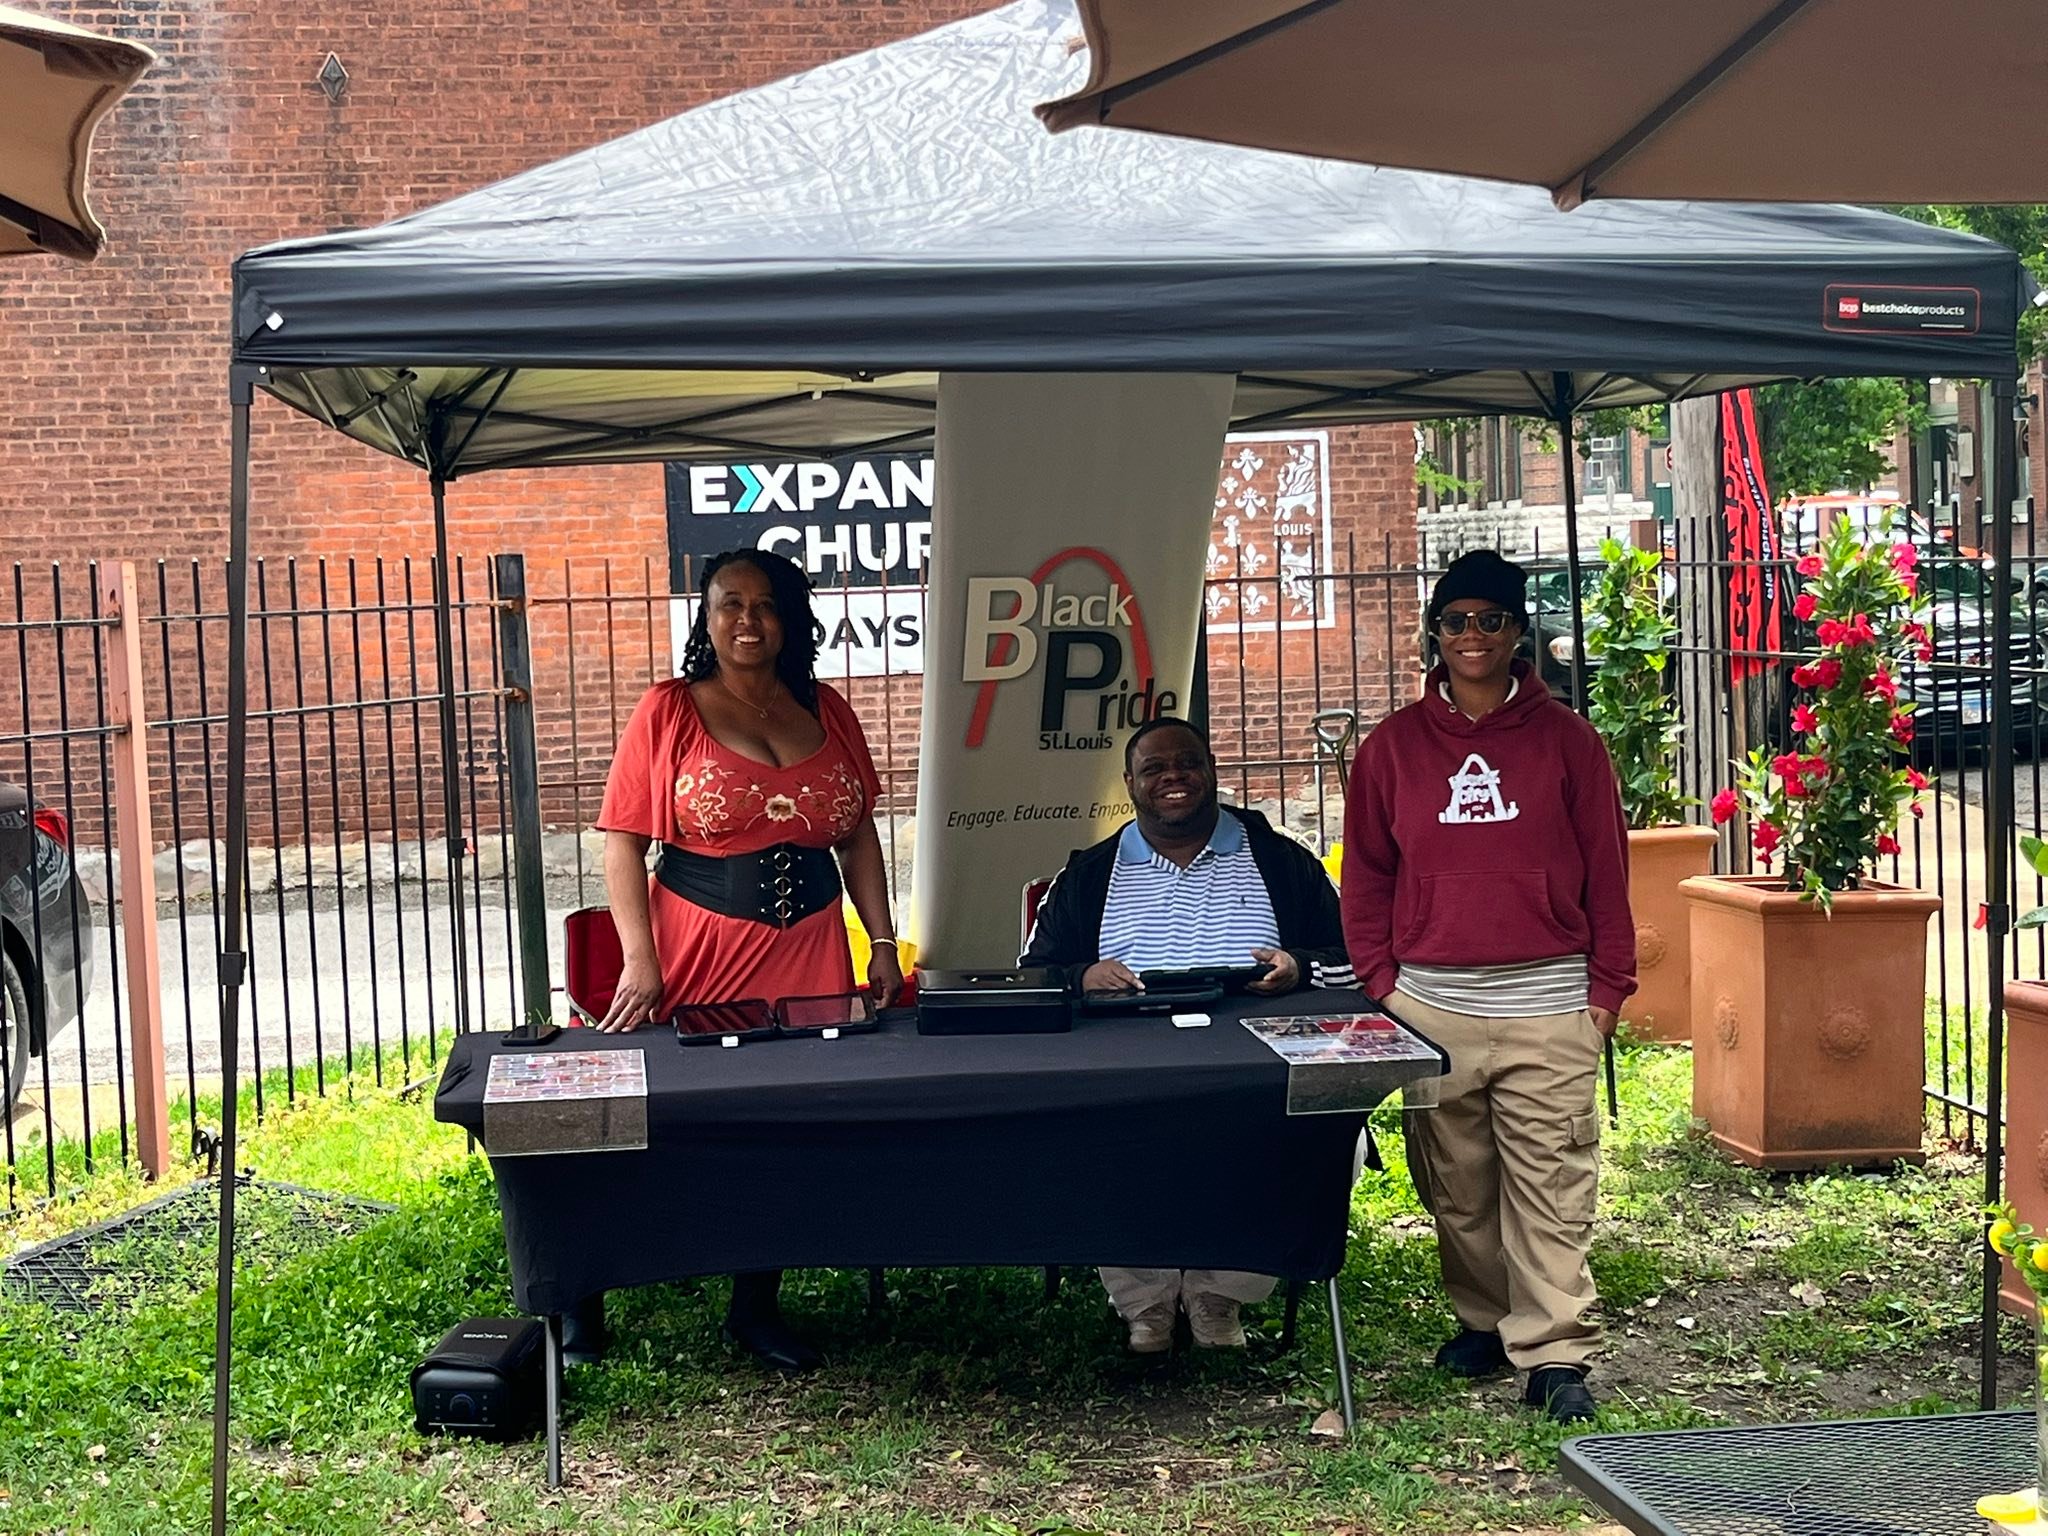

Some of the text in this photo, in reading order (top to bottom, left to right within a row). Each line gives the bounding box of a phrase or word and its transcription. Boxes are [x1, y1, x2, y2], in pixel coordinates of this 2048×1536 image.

[1862, 302, 1965, 316] bestchoiceproducts
[1273, 523, 1313, 537] LOUIS
[962, 576, 1135, 682] Black
[1040, 630, 1177, 732] Pride
[947, 810, 1007, 831] Engage.
[1013, 803, 1083, 822] Educate.
